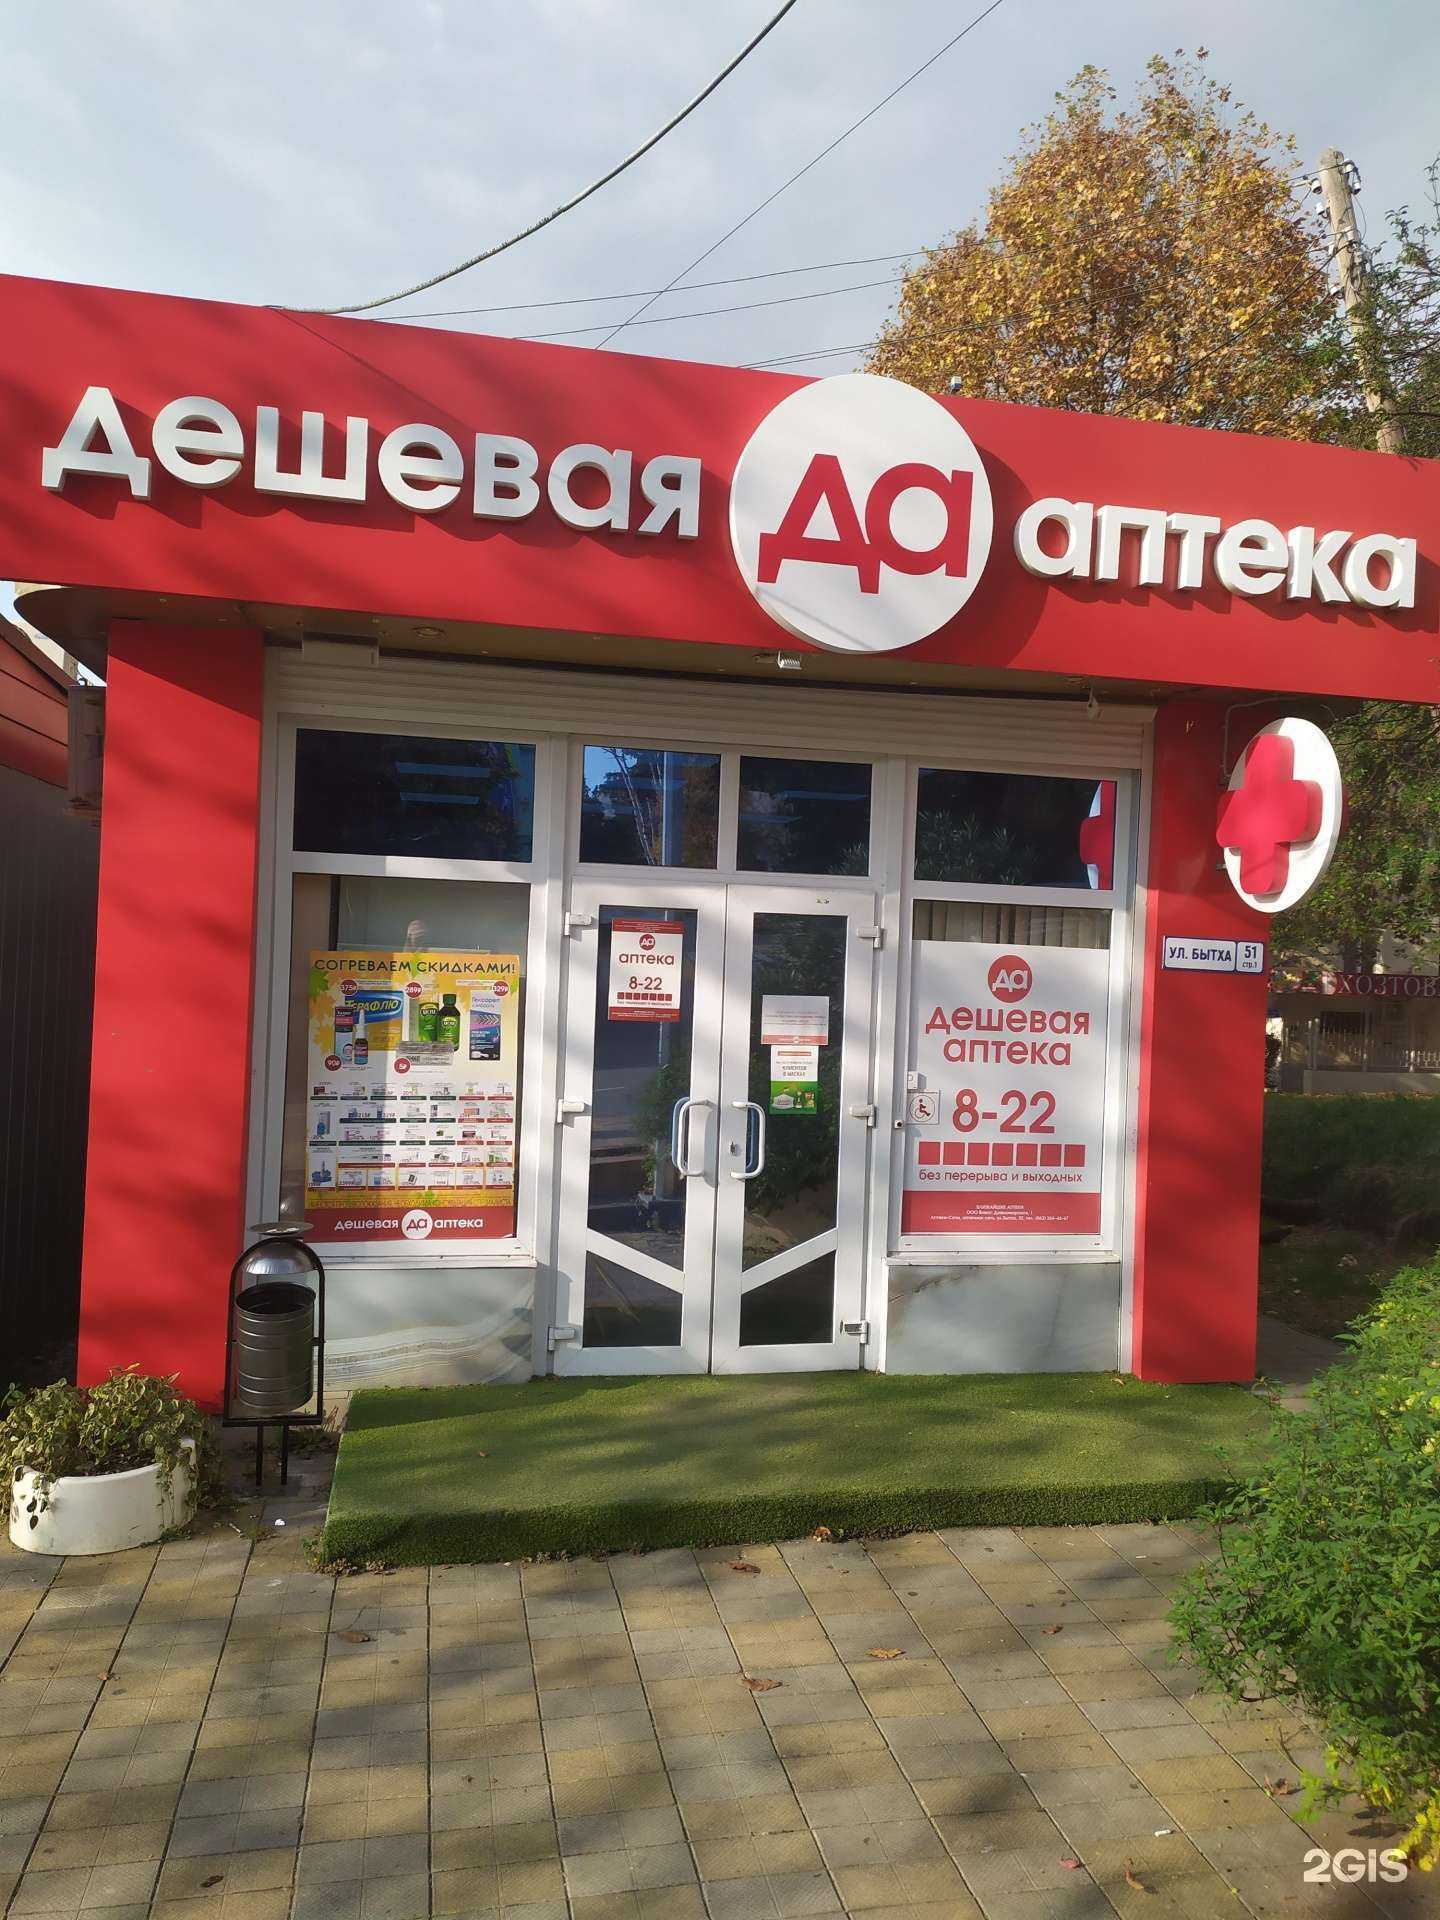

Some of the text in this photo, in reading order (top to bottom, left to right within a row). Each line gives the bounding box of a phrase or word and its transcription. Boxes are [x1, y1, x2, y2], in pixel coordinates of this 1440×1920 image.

[1014, 497, 1417, 609] аптека
[618, 953, 675, 966] аптека
[1169, 945, 1257, 962] УЛ. БЫТХА 51
[314, 959, 515, 974] СОГРЕВАЕМ СКИДКАМИ!
[629, 976, 663, 991] 8-22
[943, 1038, 1071, 1066] аптека
[952, 1088, 1056, 1134] 8-22
[919, 1169, 1083, 1183] без перерыва и выходных
[434, 1218, 484, 1229] аптека
